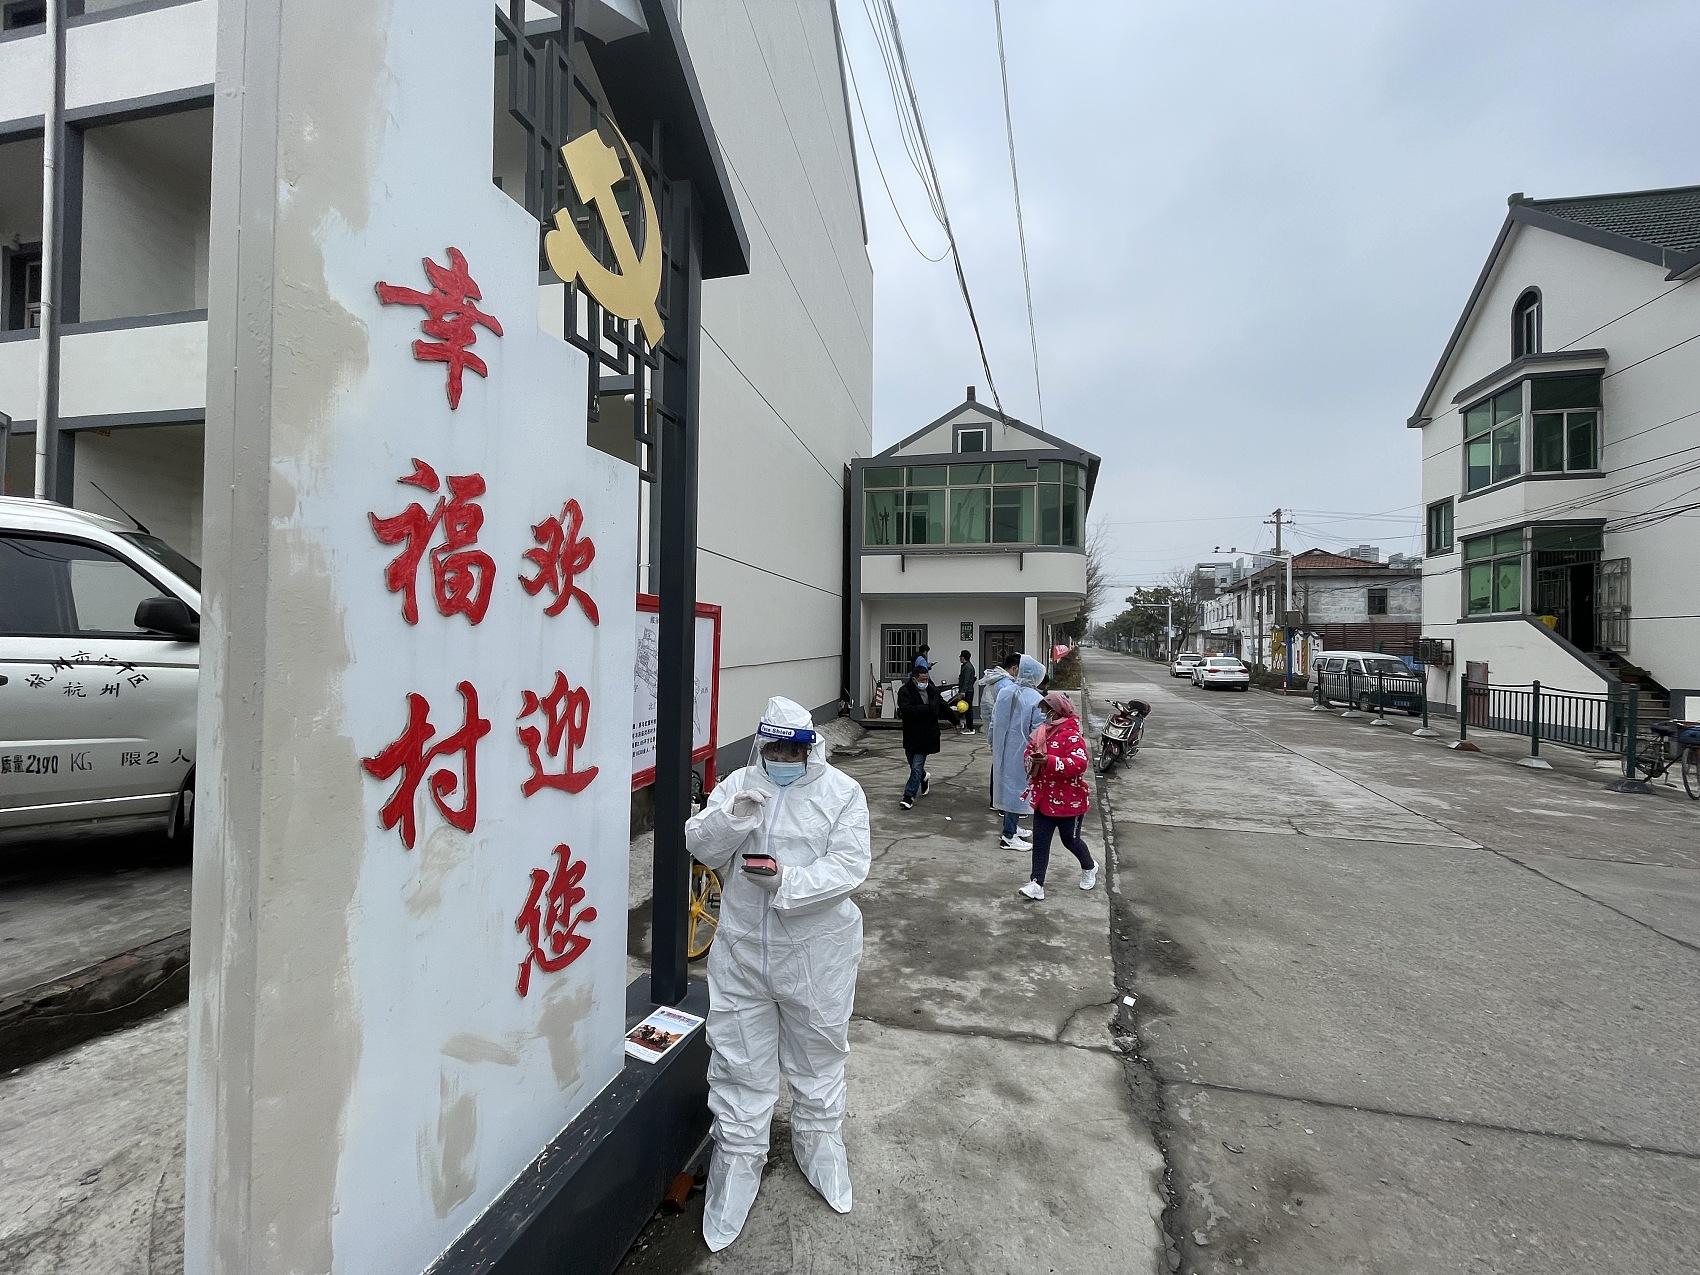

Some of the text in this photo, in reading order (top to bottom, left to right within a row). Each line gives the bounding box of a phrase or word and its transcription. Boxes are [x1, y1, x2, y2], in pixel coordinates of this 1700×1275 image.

[70, 752, 93, 772] KG
[361, 246, 503, 850] 幸福村
[515, 498, 600, 998] 欢迎您
